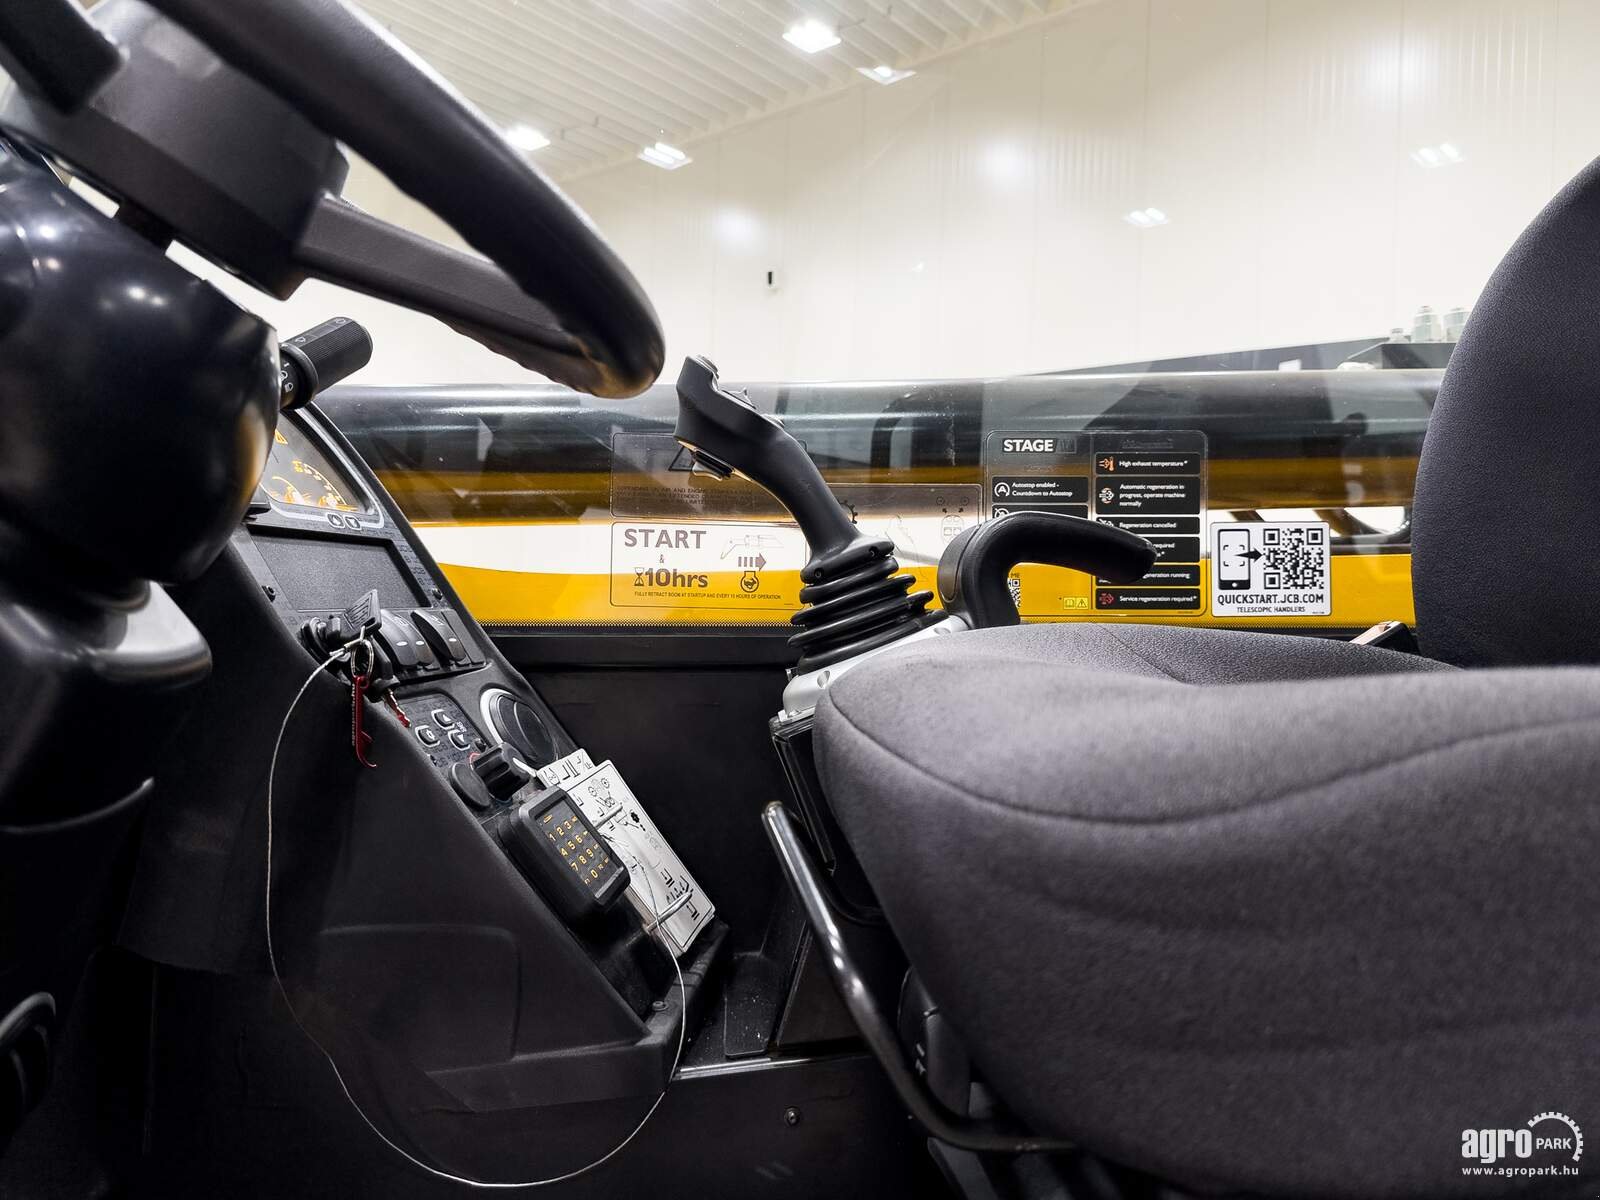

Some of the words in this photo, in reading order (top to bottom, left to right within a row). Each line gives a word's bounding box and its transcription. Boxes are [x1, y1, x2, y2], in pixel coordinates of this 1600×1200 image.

[1003, 439, 1054, 452] STAGE
[624, 528, 707, 549] START
[659, 554, 665, 564] &
[645, 568, 708, 588] 10hrs
[1217, 593, 1325, 605] QUICKSTART.JCB.COM
[549, 833, 556, 841] 1
[556, 826, 564, 836] 2
[564, 820, 572, 829] 3
[560, 847, 568, 856] 4
[567, 840, 576, 850] 5
[575, 834, 583, 843] 6
[571, 862, 579, 871] 7
[579, 855, 587, 864] 8
[586, 848, 594, 858] 9
[590, 869, 598, 878] 0
